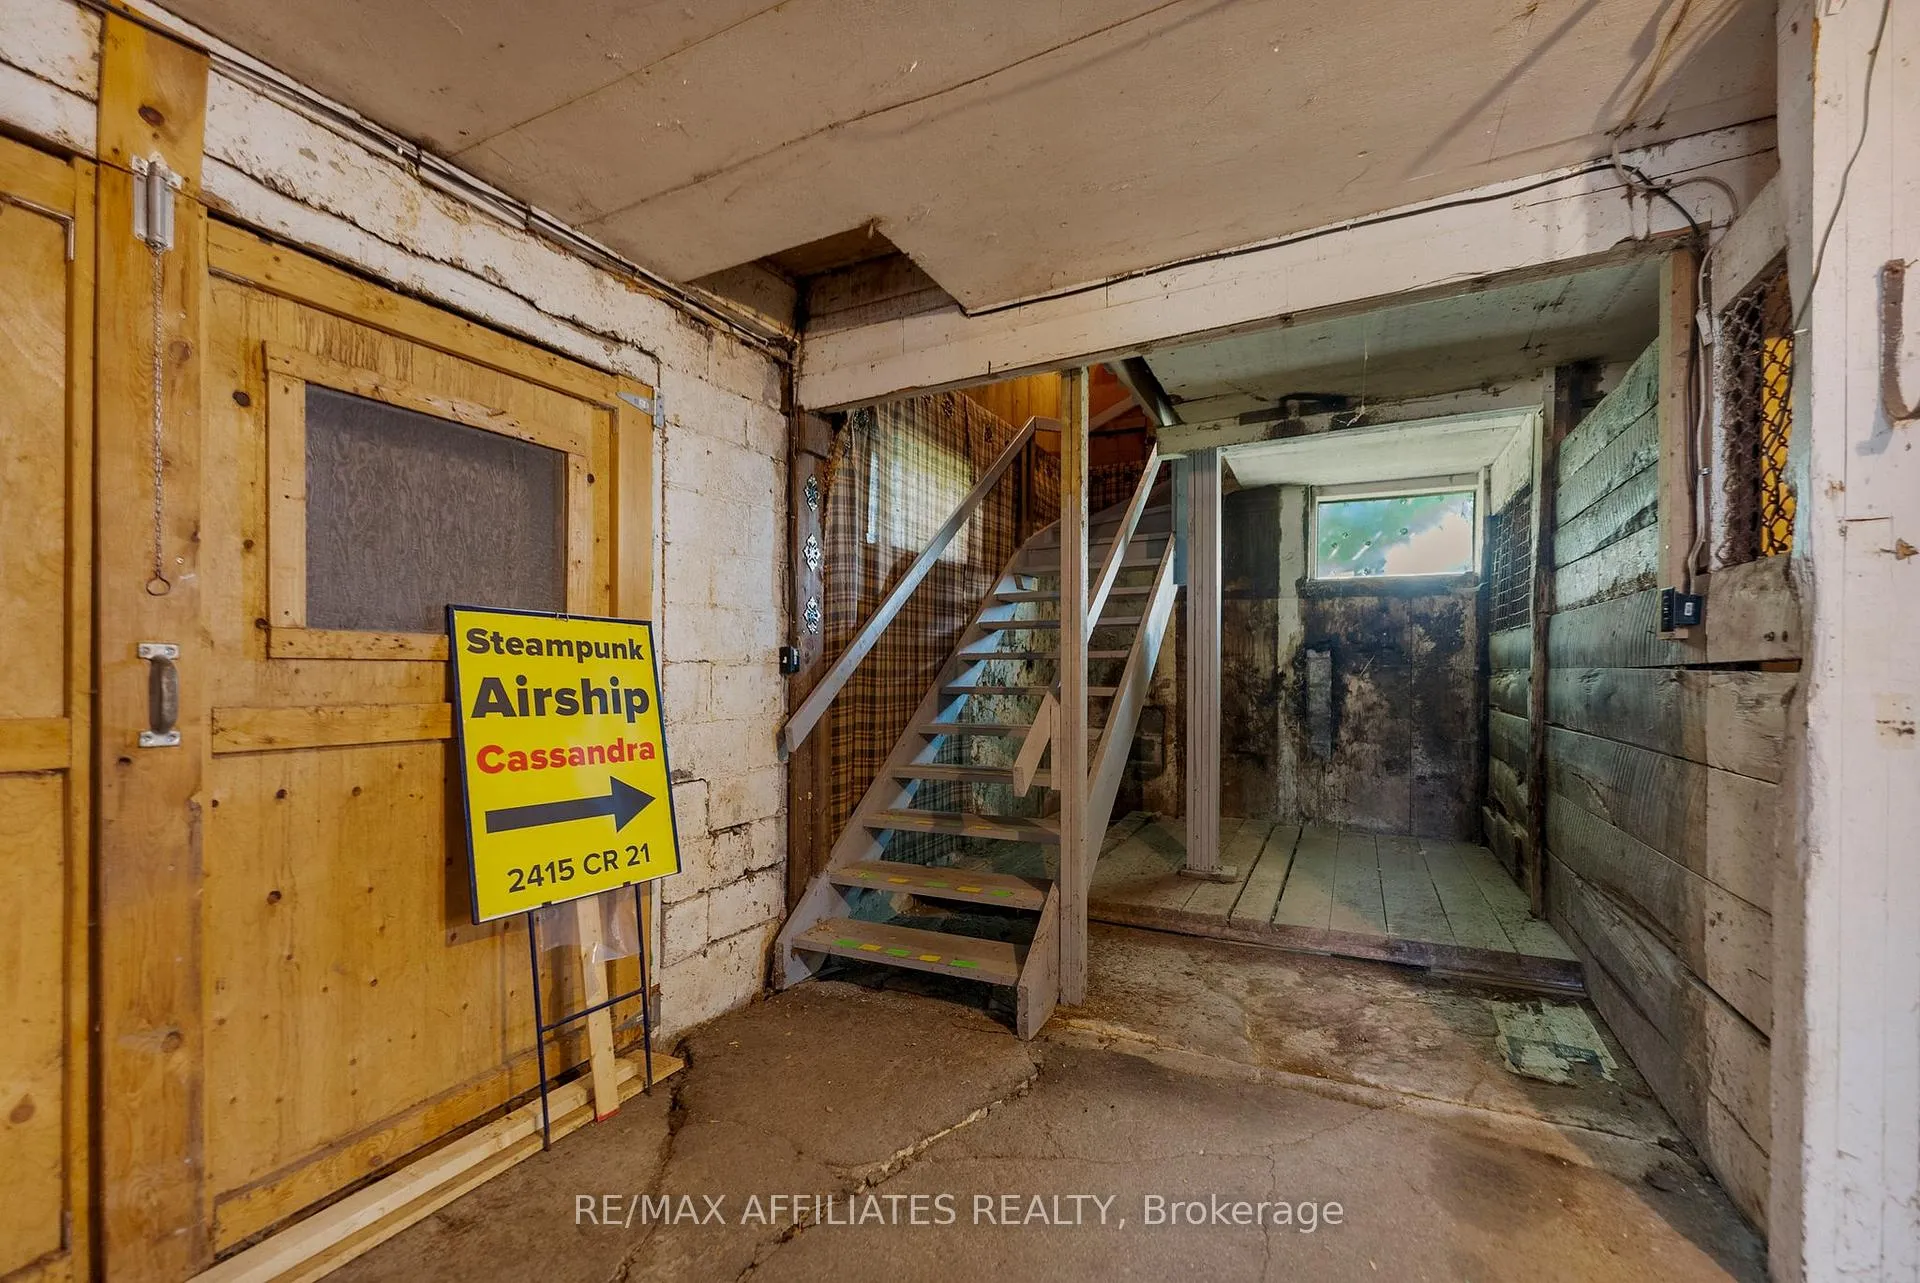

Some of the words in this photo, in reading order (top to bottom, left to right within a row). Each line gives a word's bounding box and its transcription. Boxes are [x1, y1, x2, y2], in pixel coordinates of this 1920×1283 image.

[466, 628, 644, 663] Steampunk
[471, 674, 650, 723] Airship
[477, 737, 655, 774] Cassandra
[507, 858, 575, 893] 2415
[583, 850, 618, 875] CR
[627, 843, 650, 866] 21
